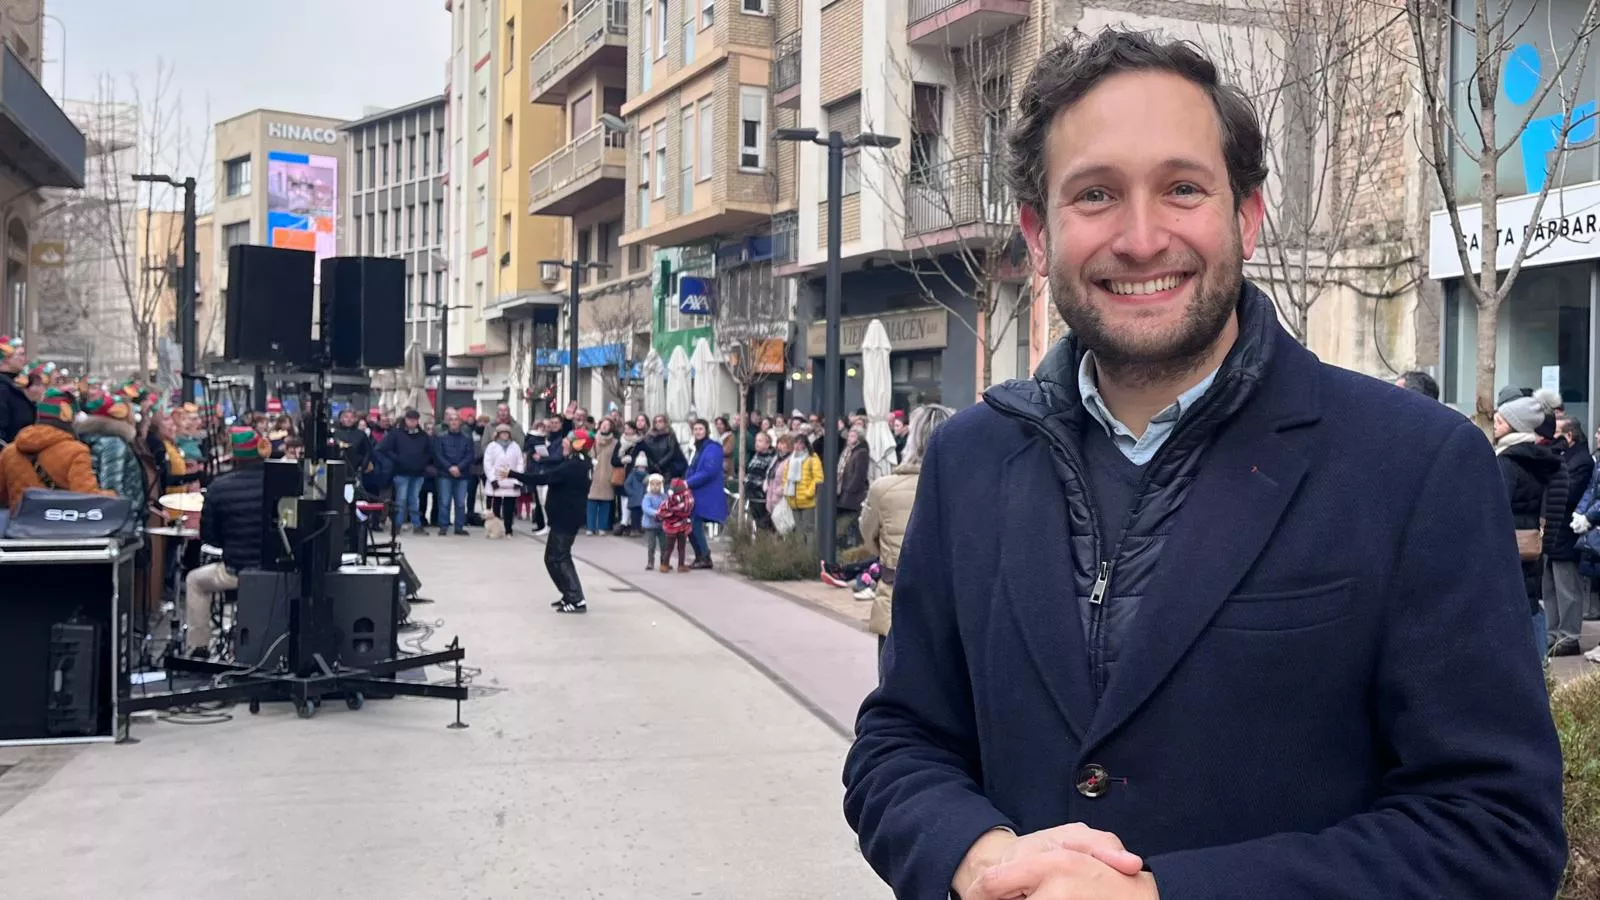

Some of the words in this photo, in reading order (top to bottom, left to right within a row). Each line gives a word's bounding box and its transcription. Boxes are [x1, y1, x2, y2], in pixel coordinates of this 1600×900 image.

[268, 121, 337, 145] HINACO
[1461, 227, 1515, 251] ATA
[1523, 213, 1600, 241] ÁRBAR
[680, 294, 710, 311] AXA
